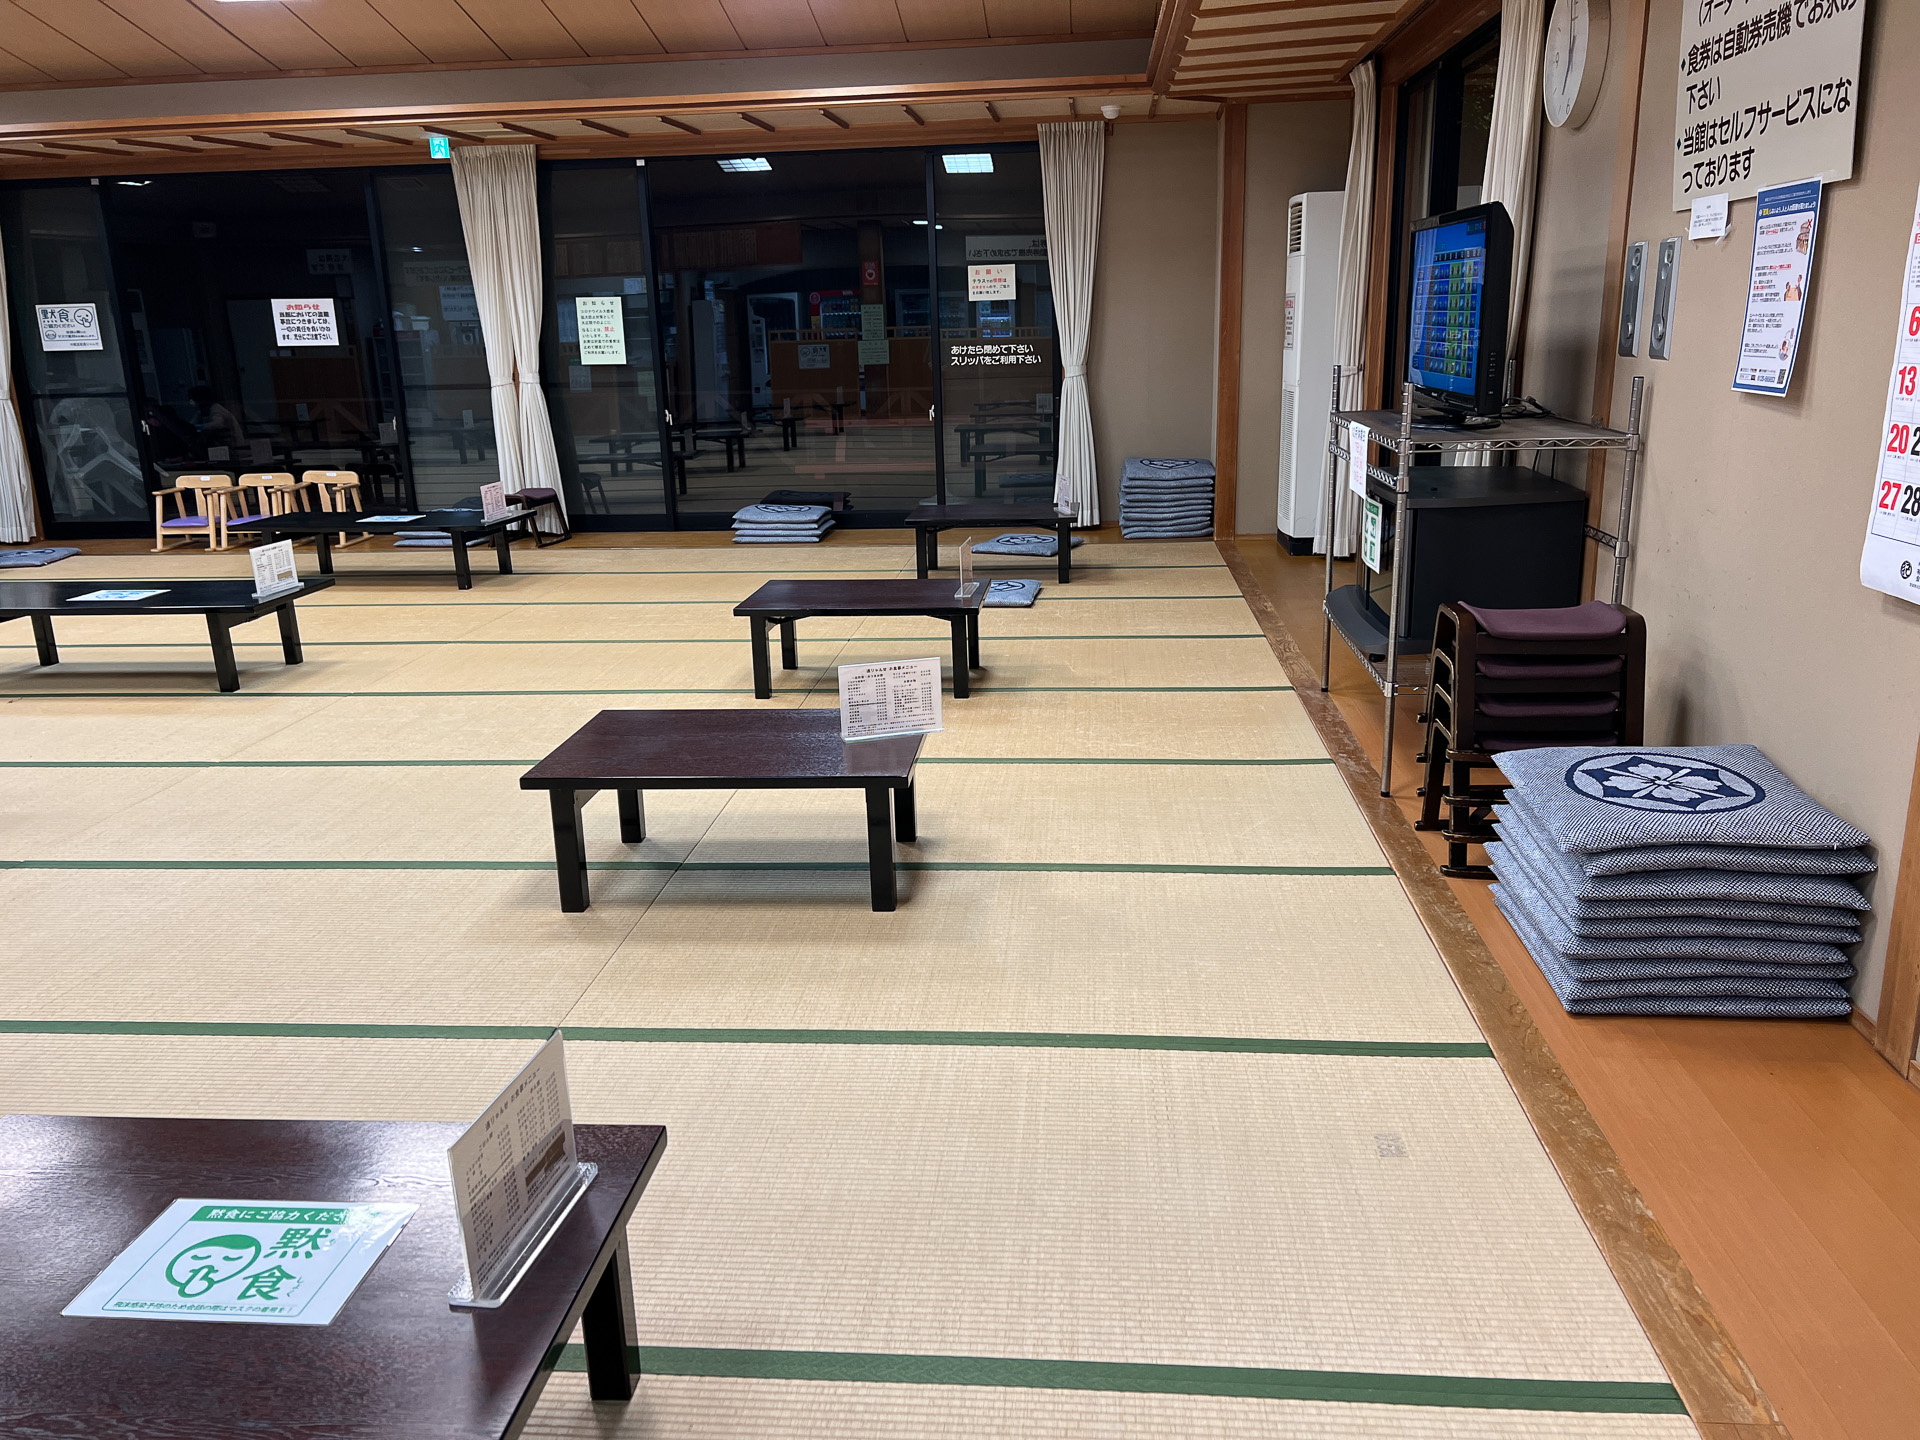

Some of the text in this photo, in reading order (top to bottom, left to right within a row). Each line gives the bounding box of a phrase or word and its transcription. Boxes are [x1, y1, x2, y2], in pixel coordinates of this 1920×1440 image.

[1686, 76, 1721, 115] 下さい
[1683, 77, 1852, 156] 当館はセルフサービスにな
[1682, 146, 1755, 193] っております
[950, 355, 1042, 366] スリッパをご利用下さい
[951, 344, 1034, 355] あけたら閉めて下さい
[1898, 365, 1917, 396] 13
[1887, 423, 1910, 454] 20
[1878, 480, 1902, 511] 27
[206, 1208, 348, 1221] 黙食にご協力くださ
